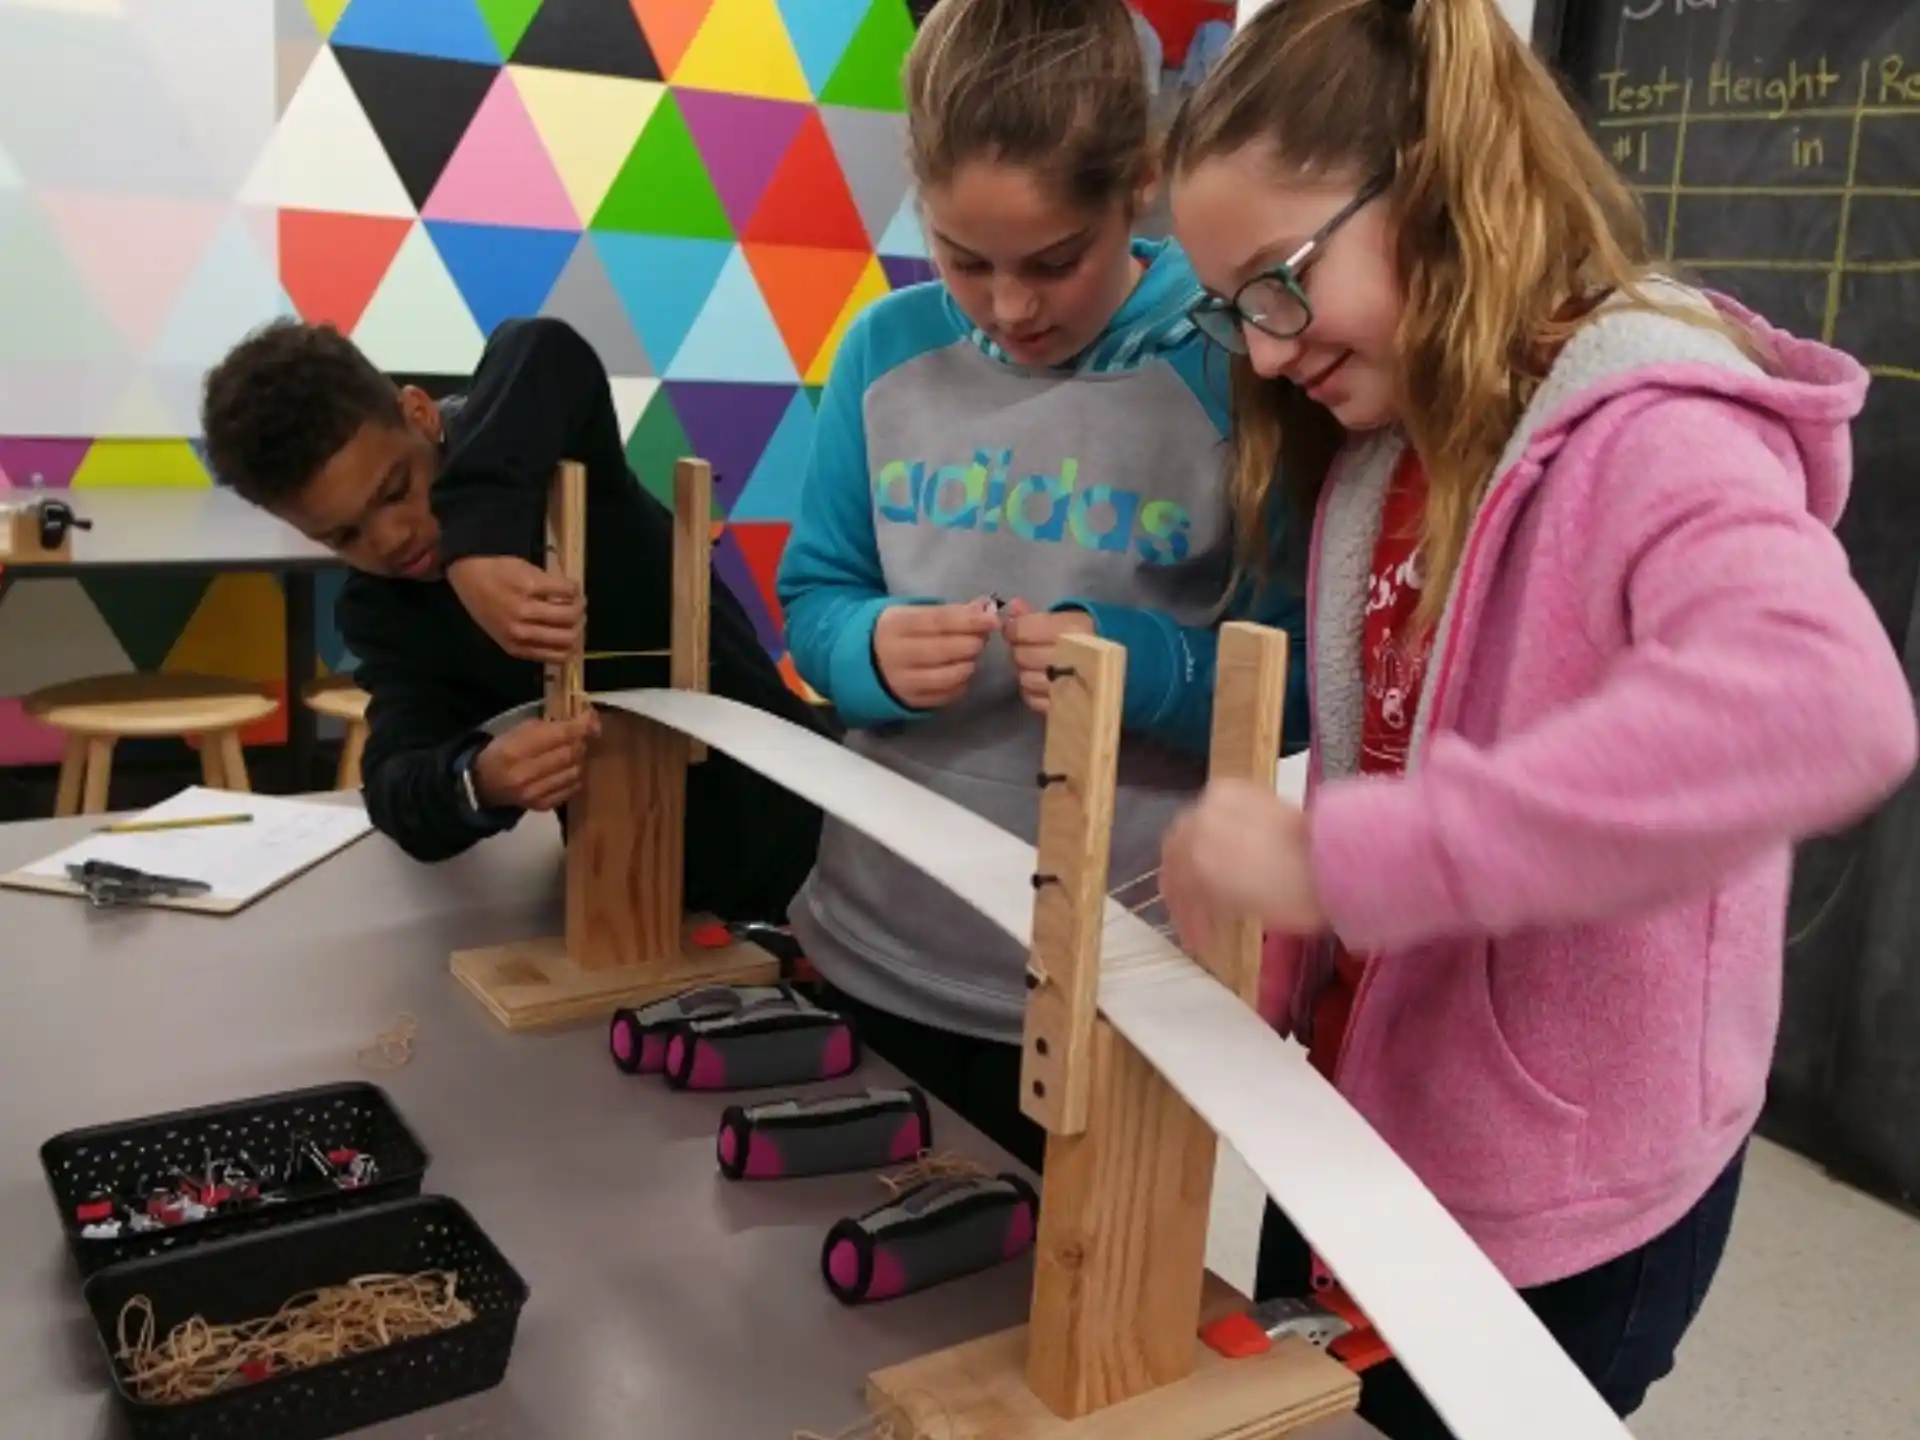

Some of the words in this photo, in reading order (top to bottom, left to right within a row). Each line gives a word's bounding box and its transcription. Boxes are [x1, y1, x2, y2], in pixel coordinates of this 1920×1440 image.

[1599, 65, 1680, 112] Test
[1707, 54, 1840, 120] Height
[1613, 131, 1648, 173] #1
[1791, 127, 1824, 168] in
[876, 446, 1191, 565] adidas
